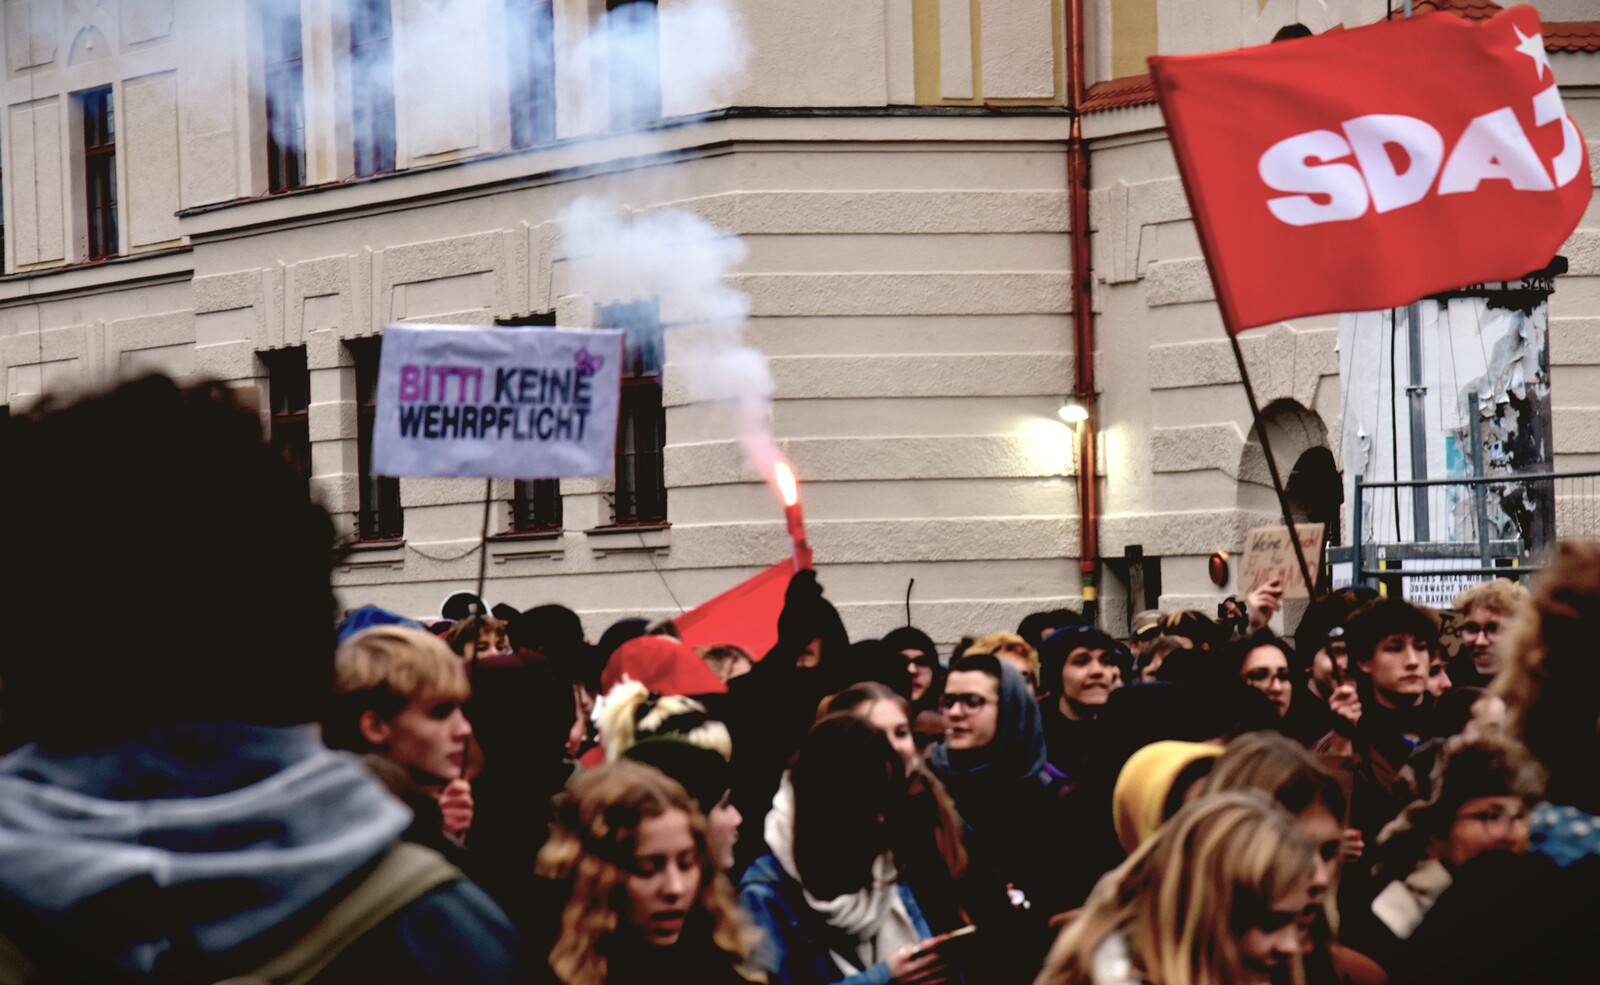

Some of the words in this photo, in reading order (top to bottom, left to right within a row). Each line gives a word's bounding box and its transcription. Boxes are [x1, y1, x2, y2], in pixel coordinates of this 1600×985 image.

[1257, 85, 1583, 226] SDAJ
[399, 364, 484, 403] BITTI
[494, 367, 592, 404] KEINE
[399, 404, 591, 442] WEHRPFLICHT
